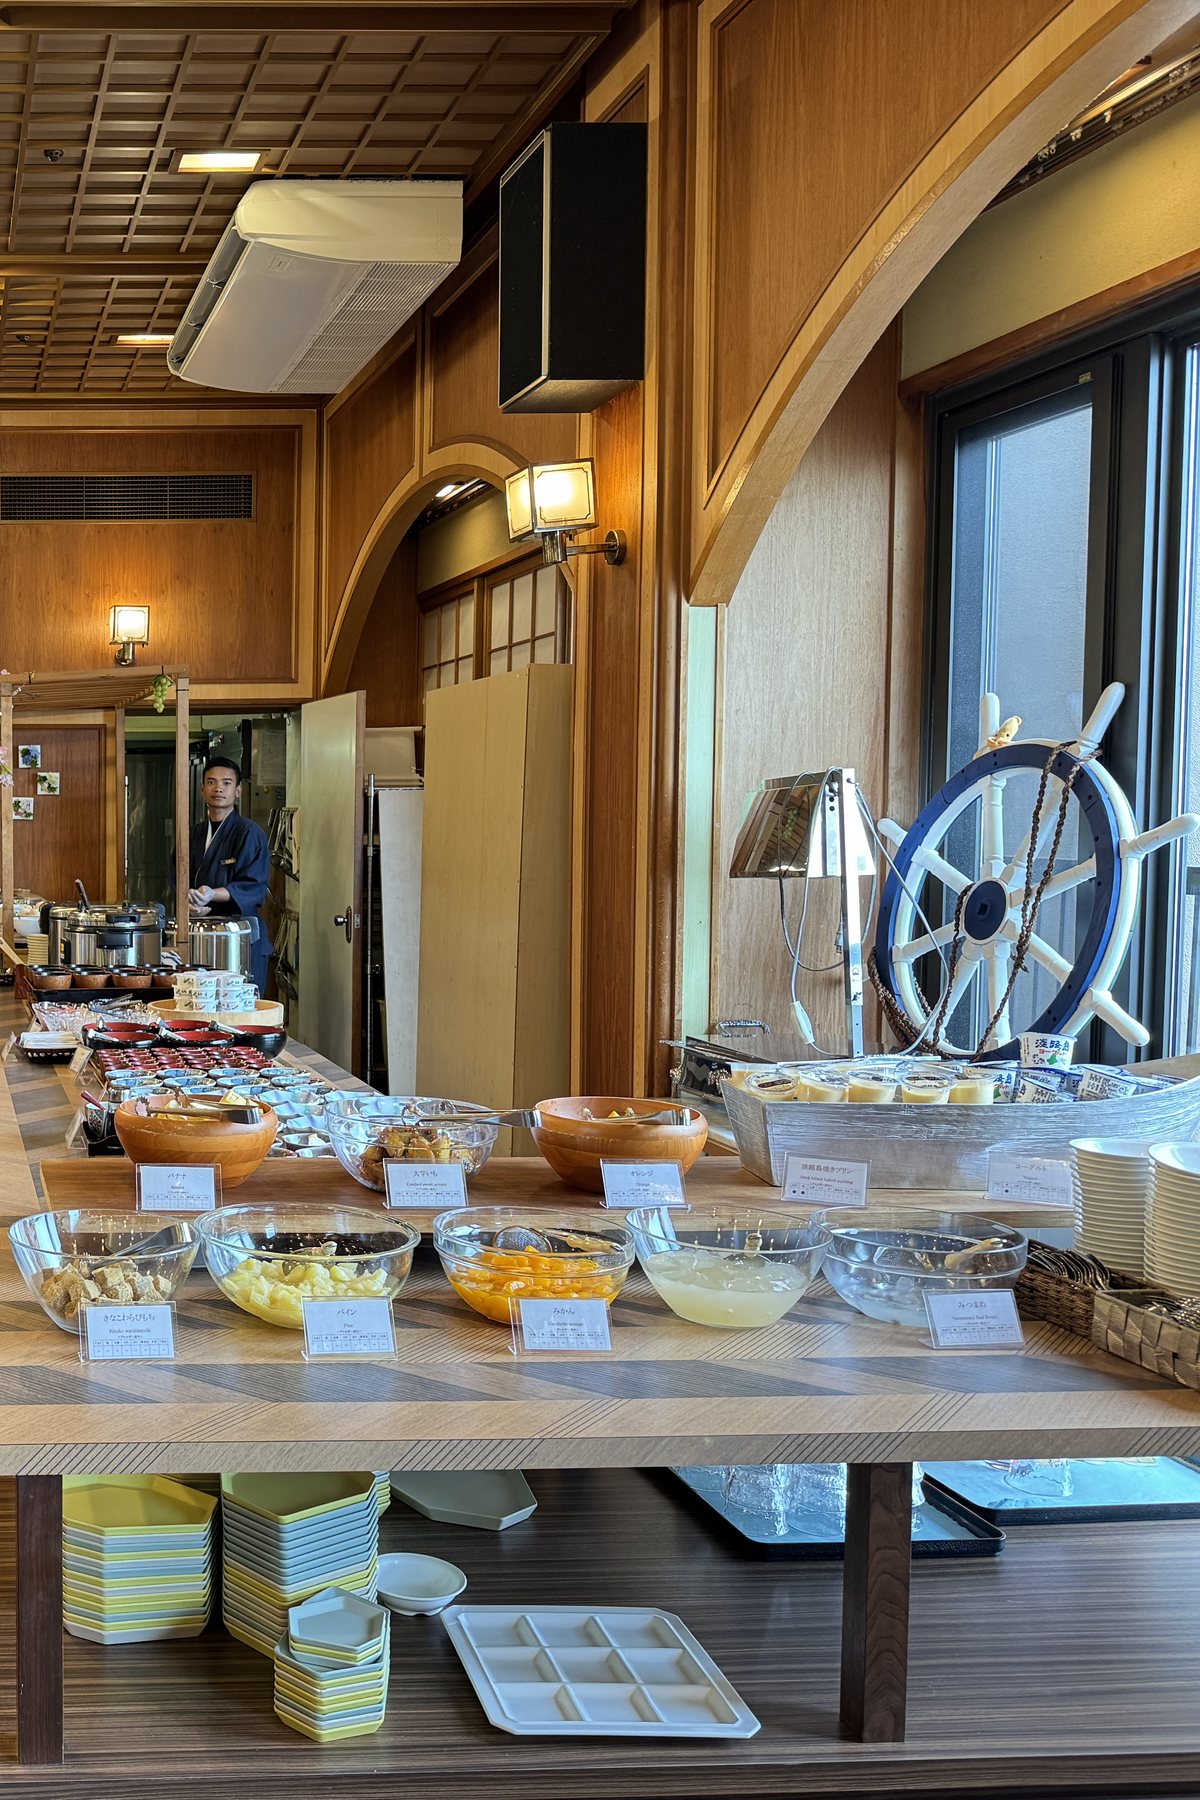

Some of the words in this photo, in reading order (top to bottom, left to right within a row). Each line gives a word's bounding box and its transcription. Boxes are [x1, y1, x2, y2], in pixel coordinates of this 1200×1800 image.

[1035, 1038, 1069, 1052] 淡路島
[801, 1163, 853, 1174] 淡路島焼きプリン
[1015, 1163, 1047, 1172] ヨーグルト
[553, 1307, 575, 1315] みかん
[103, 1313, 156, 1322] きなこわらびもち
